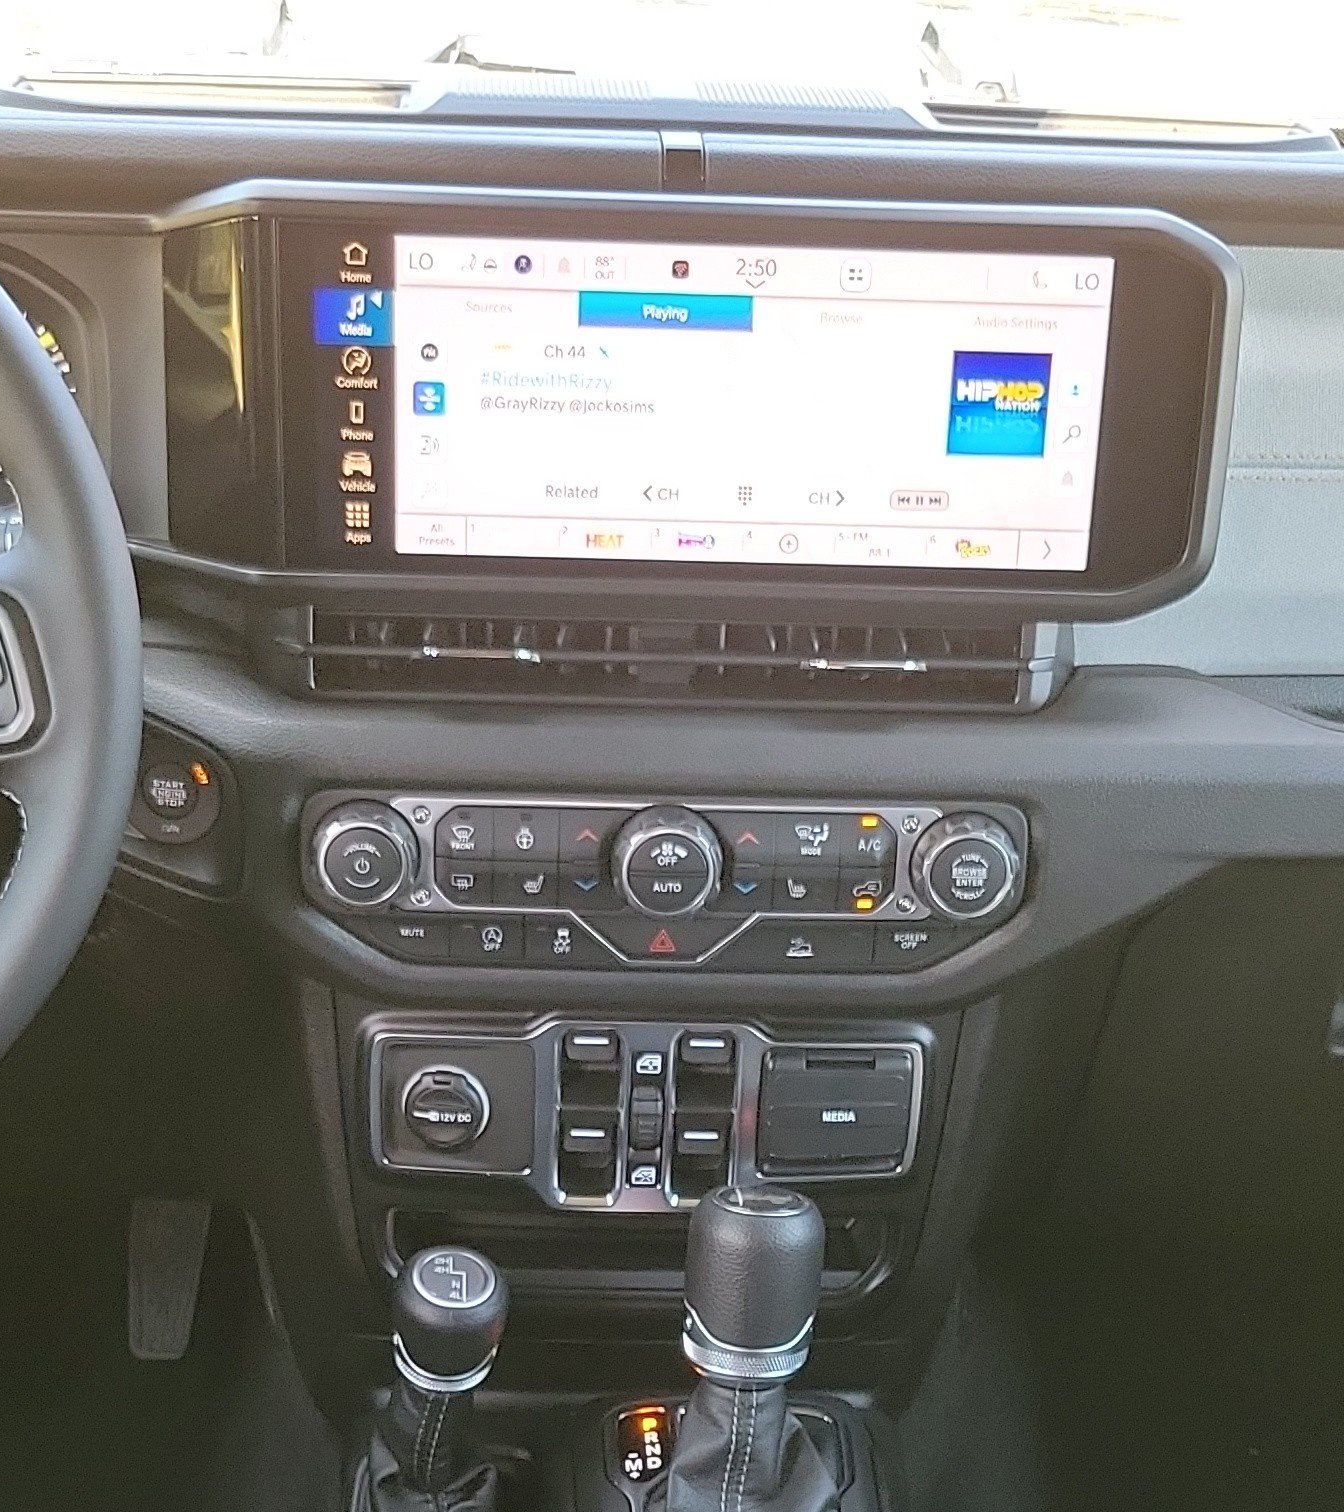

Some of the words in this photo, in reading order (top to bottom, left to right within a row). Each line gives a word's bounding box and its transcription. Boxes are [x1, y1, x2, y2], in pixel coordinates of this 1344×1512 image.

[408, 252, 434, 271] LO
[735, 258, 778, 278] 2:50
[340, 271, 373, 285] Home
[594, 269, 616, 281] OUT
[1074, 272, 1100, 292] LO
[464, 300, 514, 315] Sources
[641, 302, 690, 323] Playing
[819, 311, 864, 325] Browse
[973, 316, 1007, 330] Audio
[1009, 317, 1059, 332] Settings
[339, 322, 373, 339] Media
[544, 344, 563, 359] Ch
[567, 345, 587, 359] 44
[335, 375, 379, 391] Comfort
[480, 371, 612, 393] #RidewithRizzy
[480, 397, 566, 413] @GrayRizzy
[995, 399, 1042, 413] NATION
[340, 427, 374, 443] Phone
[339, 479, 377, 495] Vehicle
[544, 485, 599, 500] Related
[657, 486, 680, 501] CH
[809, 491, 831, 506] CH
[430, 523, 444, 533] All
[345, 530, 373, 546] Apps
[418, 536, 455, 547] Presets
[586, 533, 625, 550] HEAT
[152, 779, 186, 789] START
[151, 789, 188, 799] ENGINE
[158, 799, 186, 808] STOP
[451, 841, 475, 850] FRONT
[800, 847, 822, 857] MODE
[858, 838, 882, 852] A/C
[657, 856, 678, 867] OFF
[653, 882, 682, 894] AUTO
[956, 879, 983, 888] ENTER
[400, 927, 425, 937] MUTE
[894, 932, 927, 943] SCREEN
[900, 941, 918, 951] OFF
[440, 1112, 456, 1123] 12V
[822, 1110, 855, 1123] MEDIA
[642, 1417, 658, 1431] P
[644, 1431, 659, 1444] R
[646, 1443, 662, 1457] N
[624, 1458, 644, 1473] M
[646, 1456, 662, 1470] D
